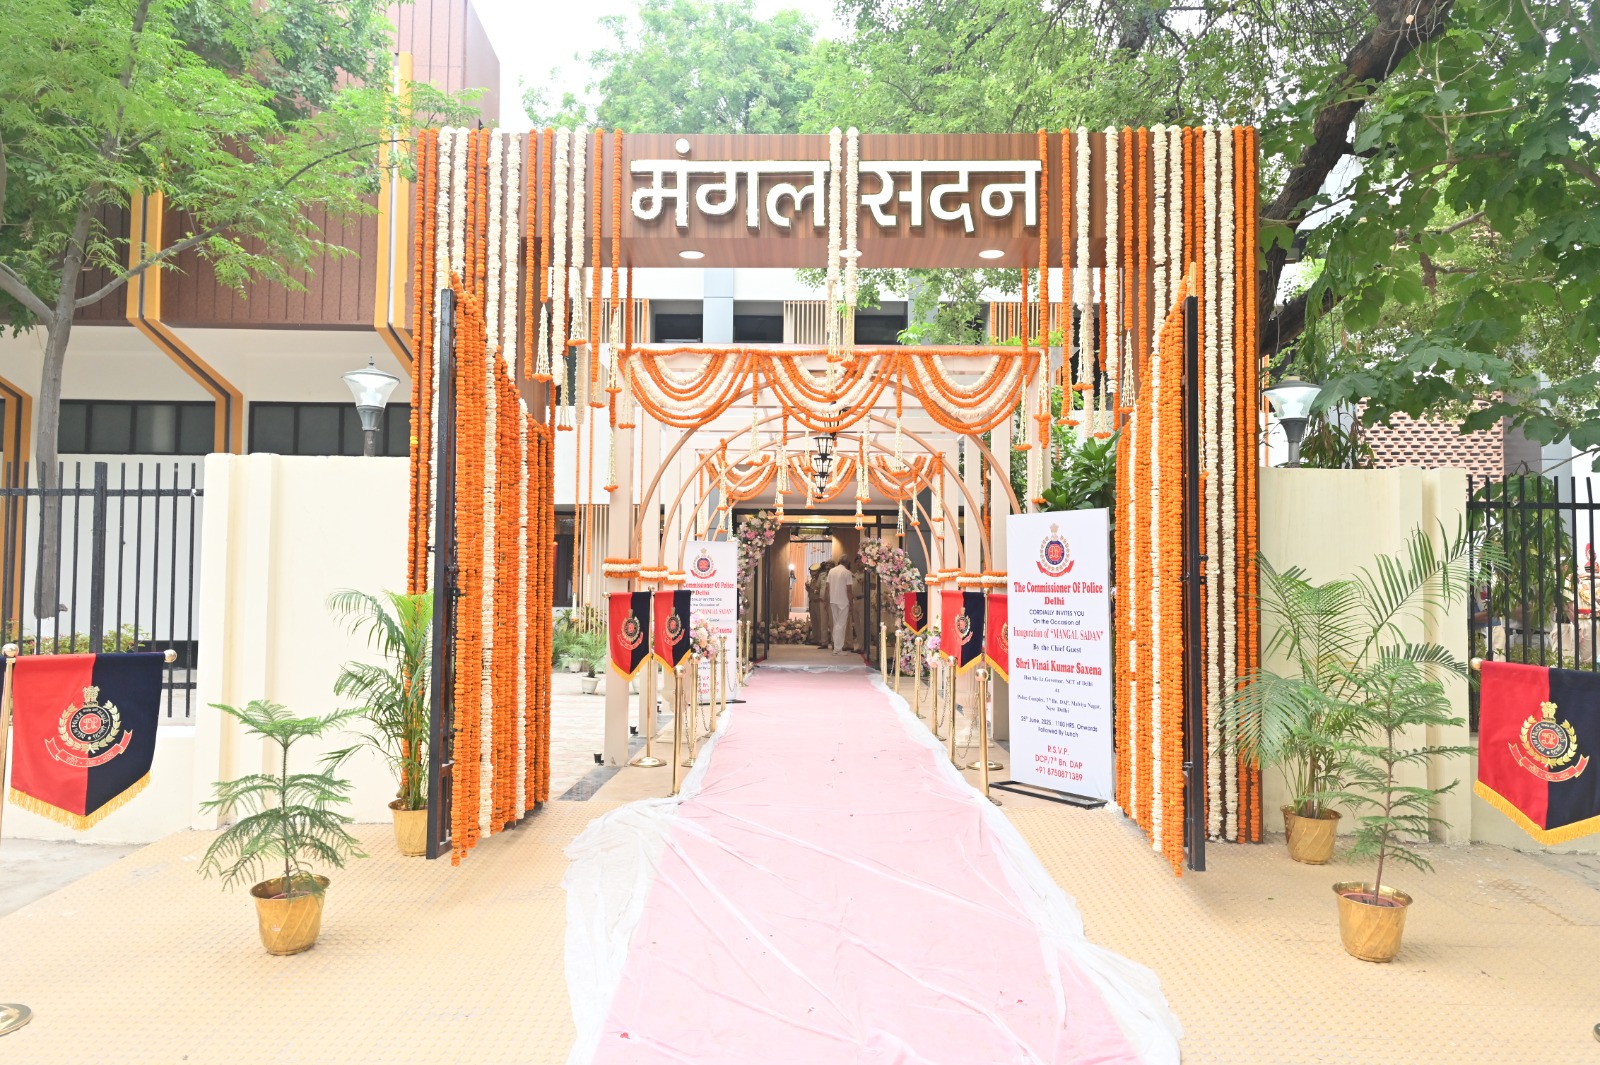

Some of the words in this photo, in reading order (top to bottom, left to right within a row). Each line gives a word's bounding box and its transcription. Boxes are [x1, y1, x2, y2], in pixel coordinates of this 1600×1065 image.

[630, 138, 830, 230] मंगल
[859, 159, 1043, 233] सदन
[1013, 582, 1025, 592] The
[1027, 582, 1071, 593] Commissioner
[1072, 582, 1080, 594] Of
[1082, 582, 1102, 594] Police
[1044, 596, 1064, 605] Delhi
[1013, 627, 1042, 639] Inauguration
[1044, 628, 1049, 638] of
[1016, 658, 1030, 669] Shri
[1032, 659, 1049, 671] Vinai
[1051, 660, 1074, 673] Kumar
[1076, 662, 1102, 676] Saxena
[1038, 726, 1057, 734] Followed
[1077, 724, 1098, 732] Onwards
[1059, 759, 1067, 767] Bn.
[1070, 760, 1082, 769] DAP
[1048, 768, 1083, 781] 8750871389
